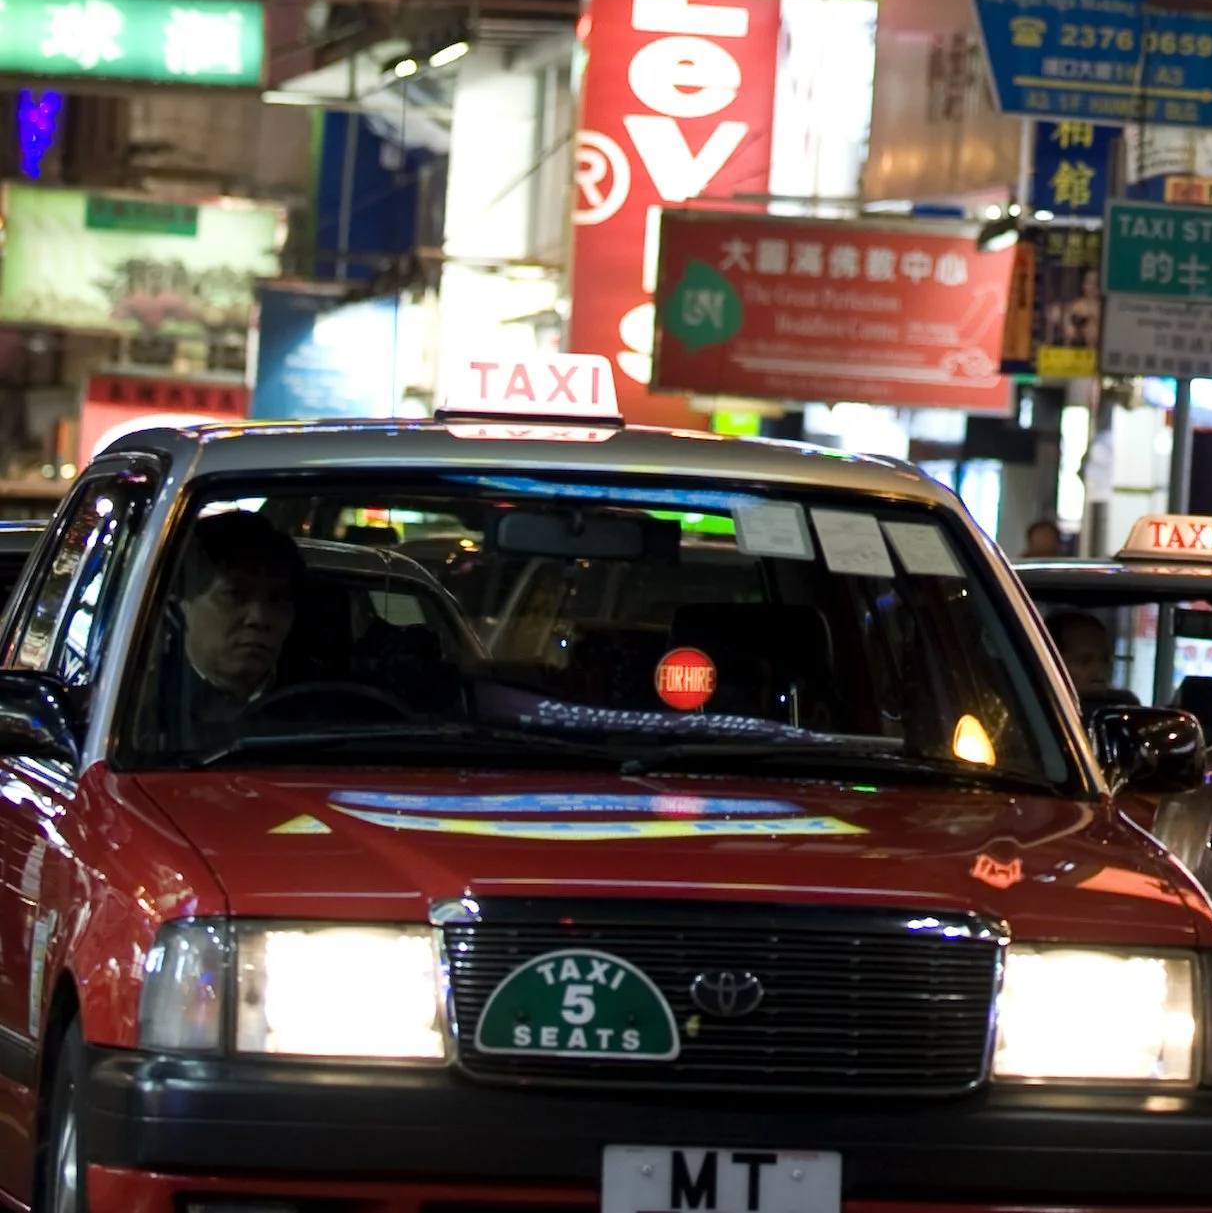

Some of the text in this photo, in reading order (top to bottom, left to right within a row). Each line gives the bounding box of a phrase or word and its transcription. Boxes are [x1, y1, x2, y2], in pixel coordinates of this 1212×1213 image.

[1061, 24, 1133, 50] 2376
[1118, 214, 1175, 240] TAXI
[470, 361, 601, 404] TAXI
[659, 665, 713, 693] FOR HIRE
[537, 958, 626, 989] TAXI
[561, 985, 595, 1024] 5
[513, 1025, 640, 1051] SEATS
